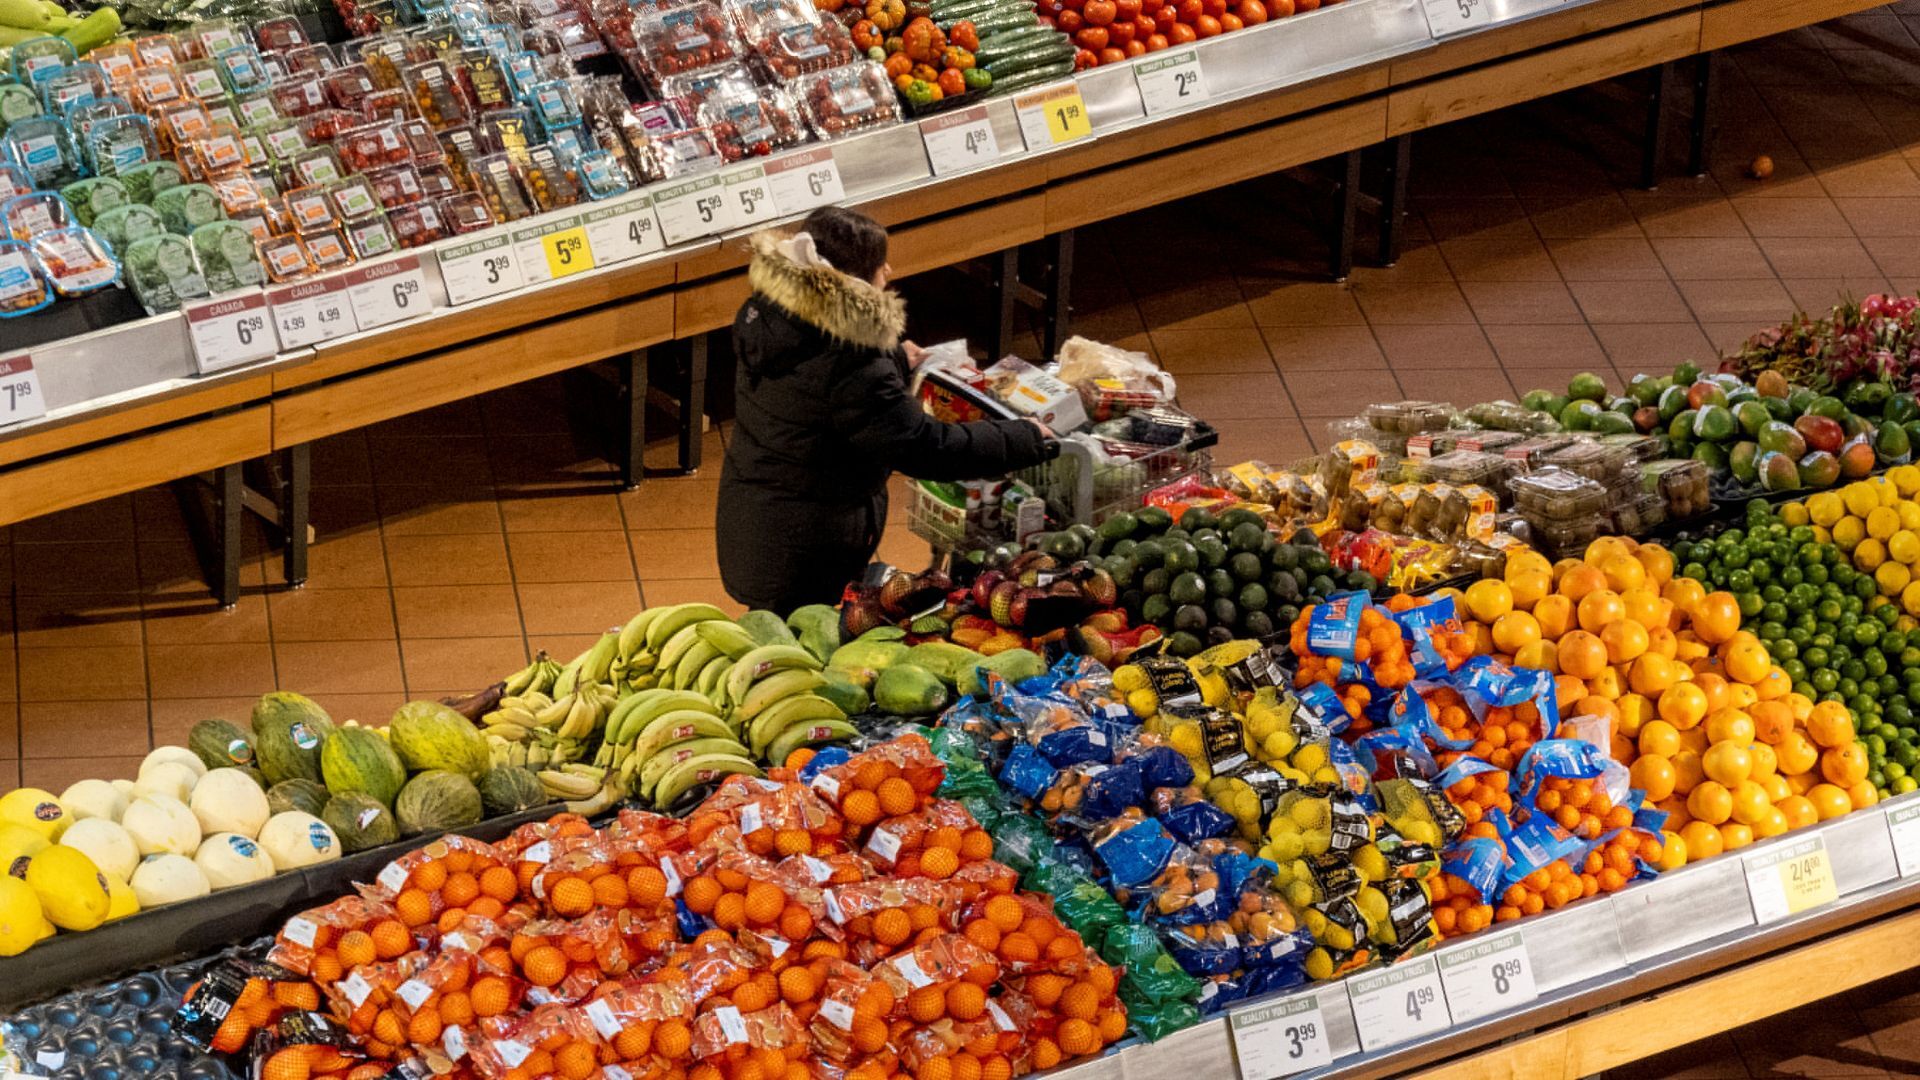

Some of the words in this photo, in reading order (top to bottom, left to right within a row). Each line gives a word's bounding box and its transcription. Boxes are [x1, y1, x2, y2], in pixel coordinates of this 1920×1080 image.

[1056, 105, 1079, 132] 199
[965, 129, 988, 155] 499
[783, 155, 815, 169] CANADA
[807, 169, 832, 197] 699
[696, 195, 723, 223] 599
[738, 187, 765, 215] 599
[628, 217, 652, 245] 499
[554, 236, 582, 265] 599
[365, 261, 400, 280] CANADA
[483, 255, 510, 285] 399
[290, 283, 327, 299] CANADA
[392, 279, 420, 309] 699
[209, 300, 246, 317] CANADA
[283, 316, 306, 332] 4.99
[317, 307, 341, 323] 4.99
[236, 316, 264, 346] 699
[2, 381, 32, 411] 799
[1446, 948, 1476, 966] QUALITY
[1475, 944, 1493, 957] YOU
[1492, 935, 1516, 952] TRUST
[1357, 976, 1387, 994] QUALITY
[1387, 971, 1404, 985] YOU
[1404, 964, 1427, 981] TRUST
[1490, 958, 1521, 995] 899
[1240, 1009, 1270, 1025] QUALITY
[1270, 1005, 1287, 1018] YOU
[1287, 999, 1310, 1014] TRUST
[1405, 985, 1435, 1022] 499
[1284, 1022, 1316, 1059] 399
